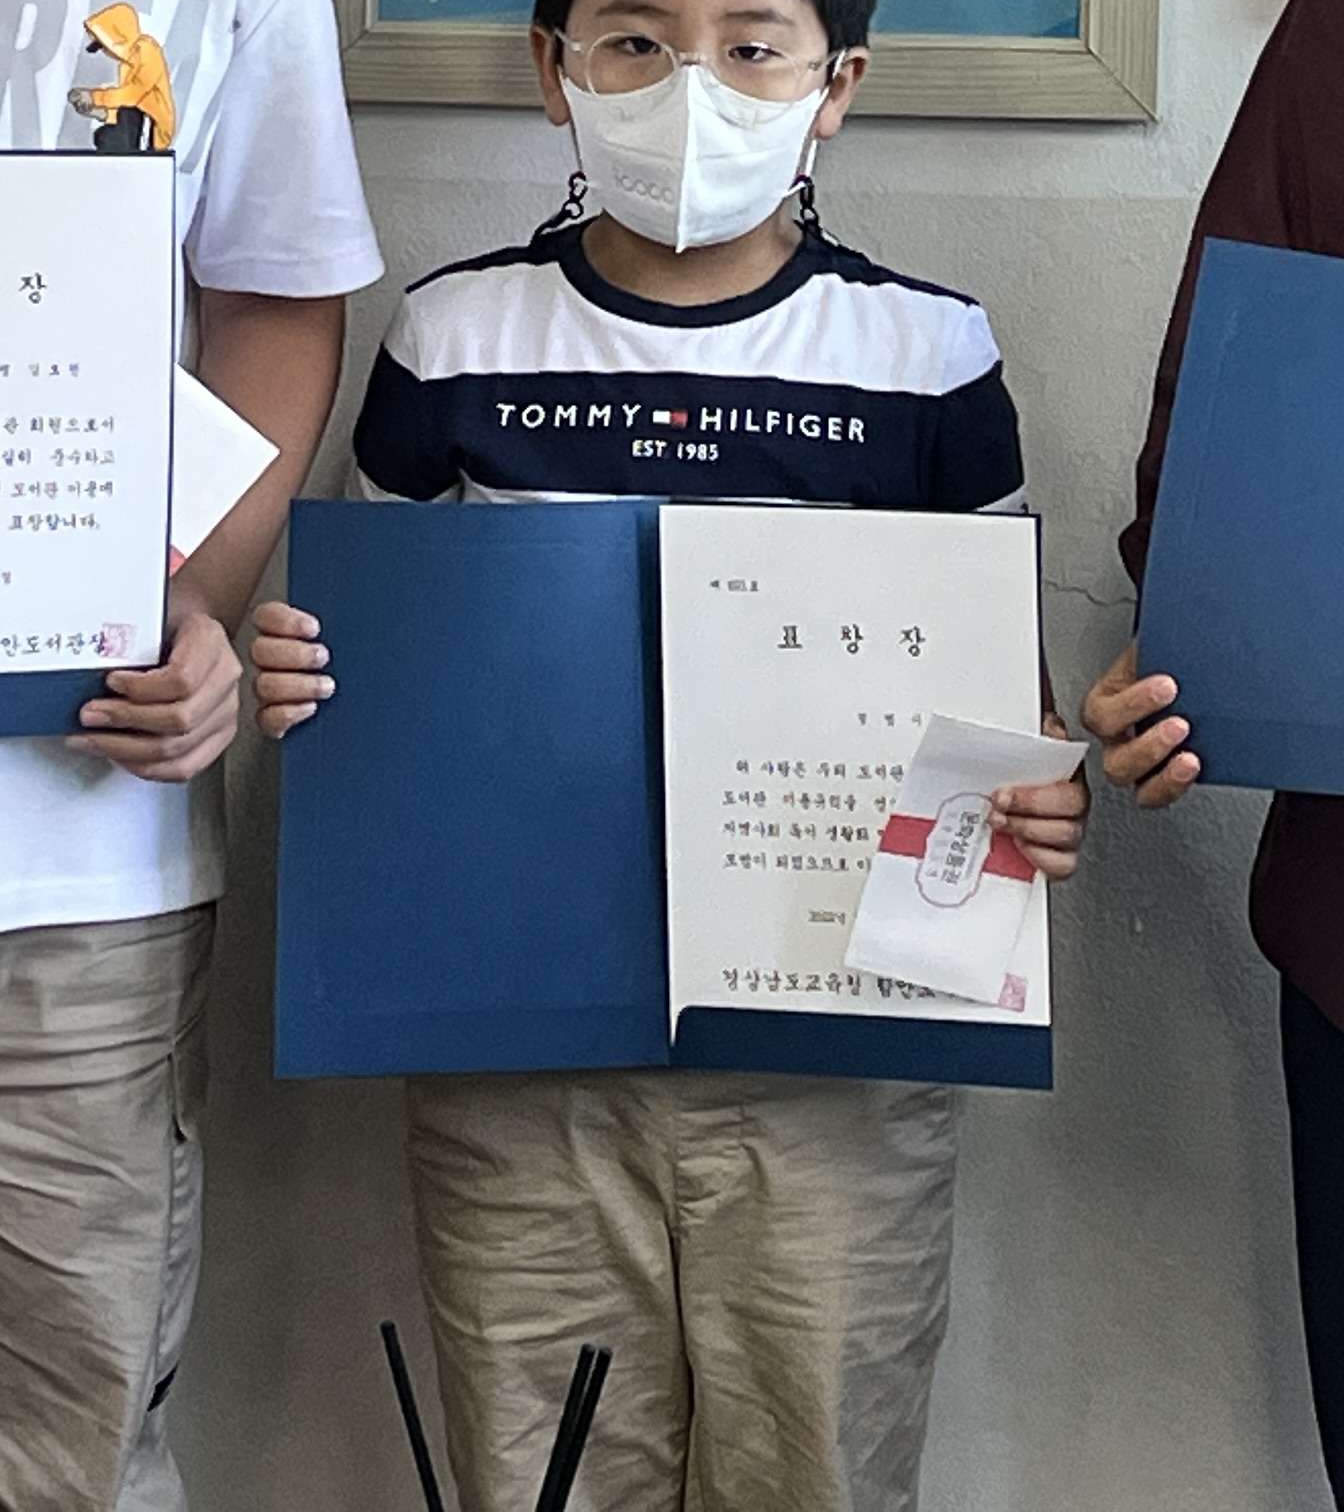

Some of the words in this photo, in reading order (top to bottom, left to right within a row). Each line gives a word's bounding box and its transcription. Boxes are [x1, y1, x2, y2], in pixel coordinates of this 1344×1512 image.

[18, 272, 48, 305] 장
[495, 402, 642, 429] TOMMY
[699, 406, 867, 444] HILFIGER
[631, 439, 666, 459] EST
[676, 441, 719, 462] 1985
[899, 625, 926, 657] 장
